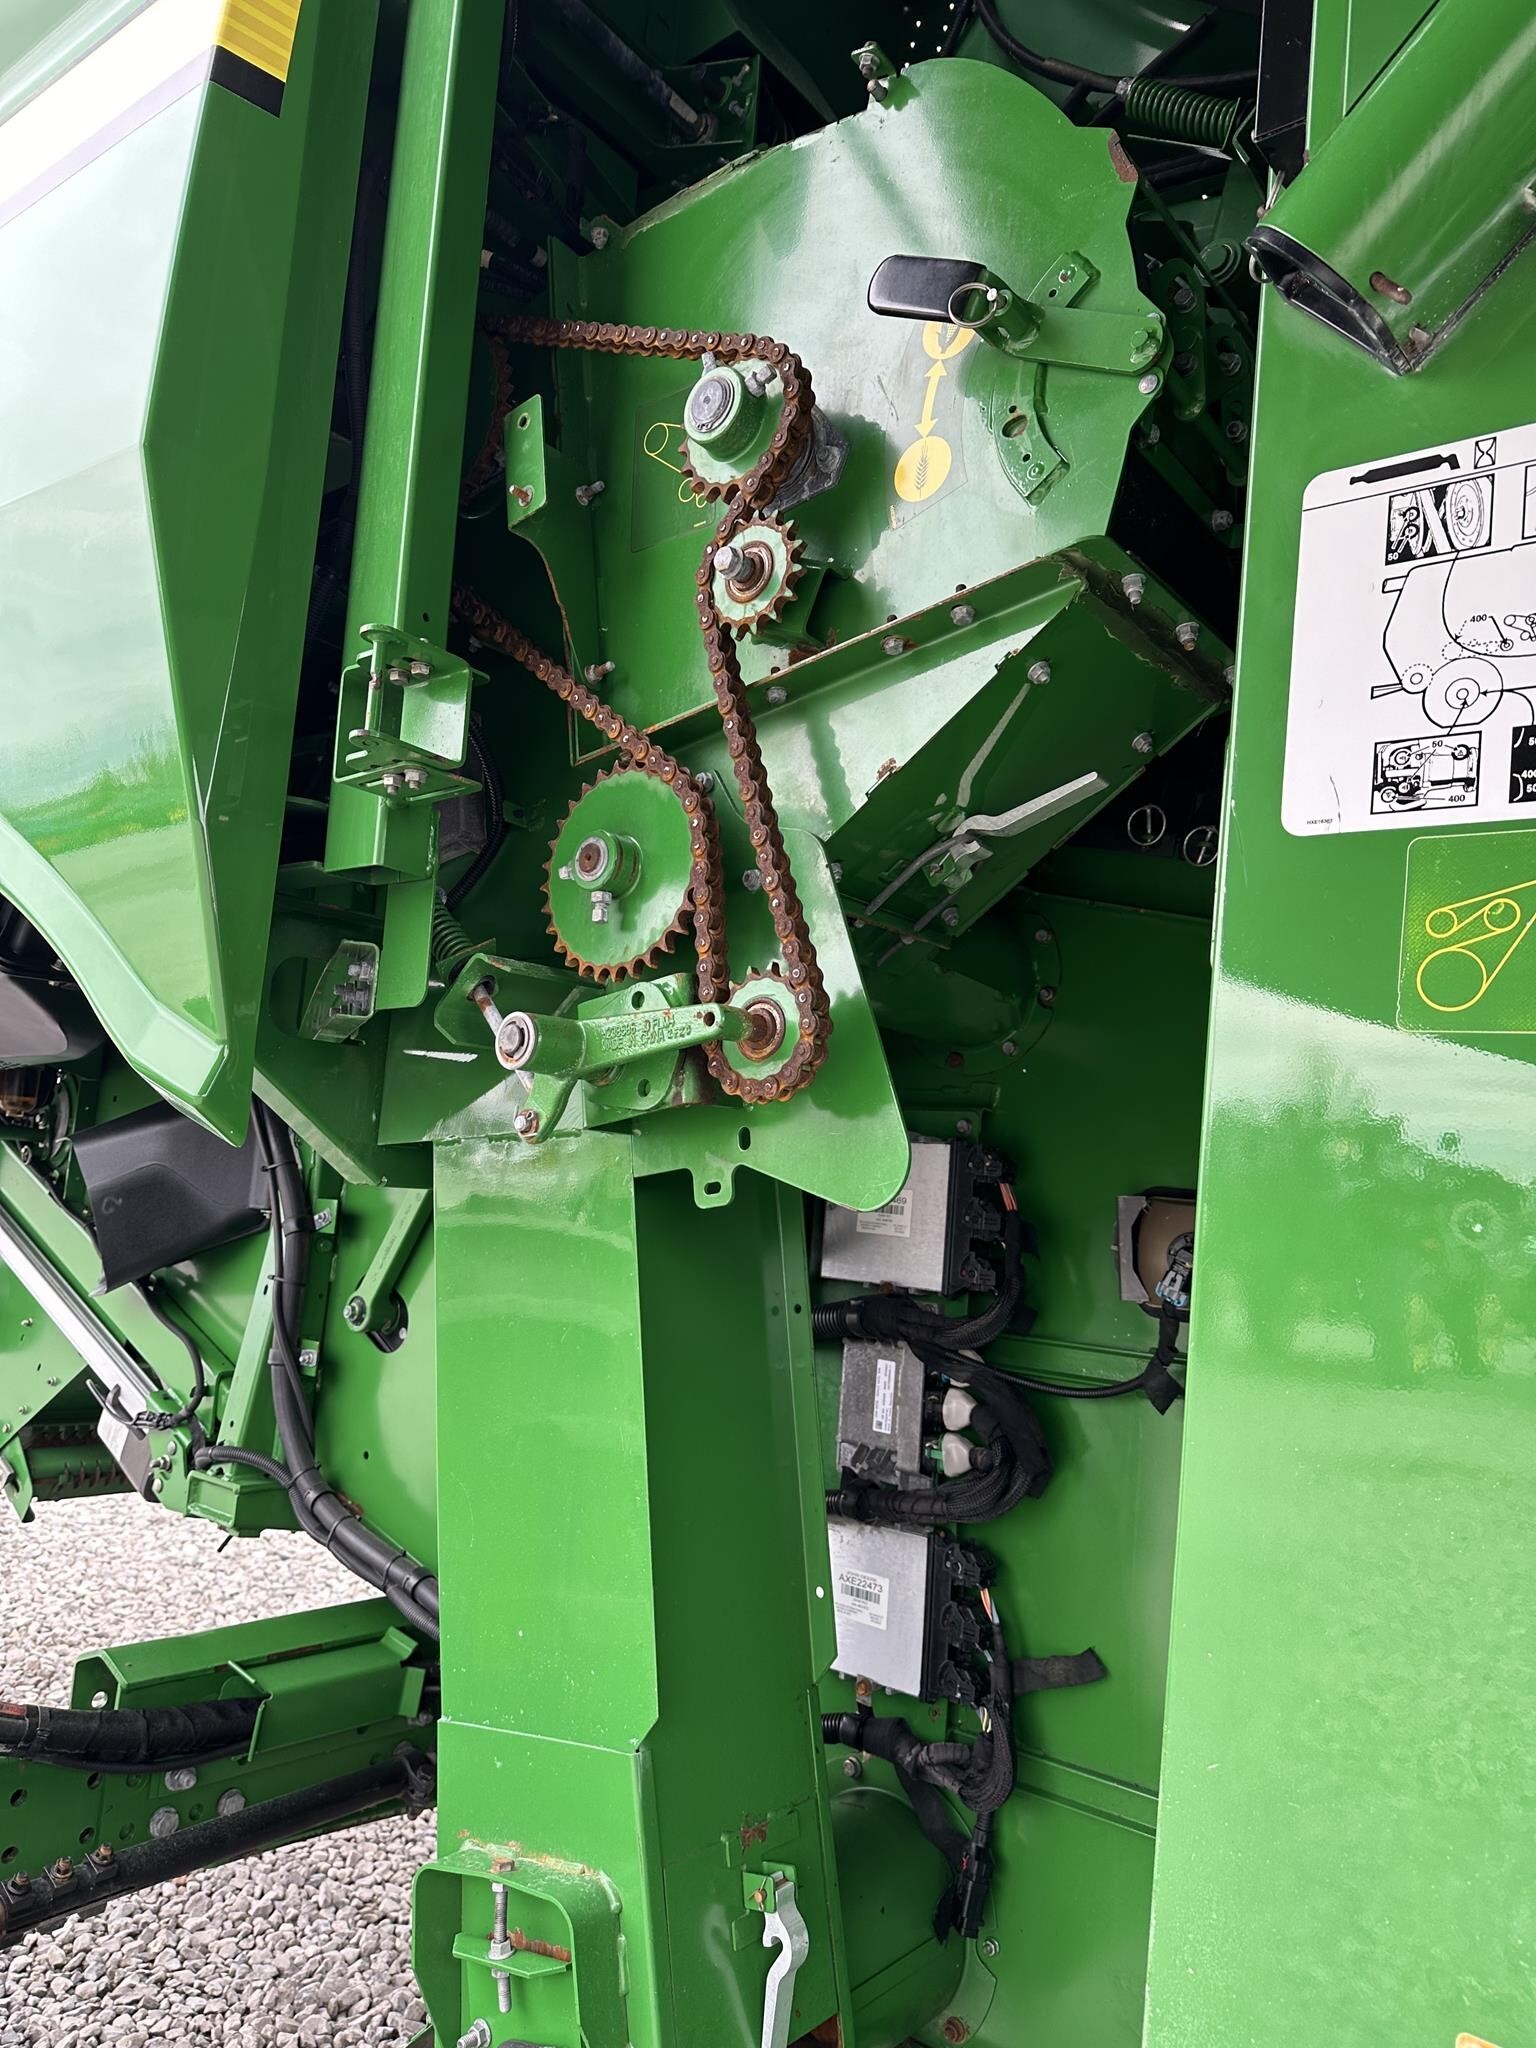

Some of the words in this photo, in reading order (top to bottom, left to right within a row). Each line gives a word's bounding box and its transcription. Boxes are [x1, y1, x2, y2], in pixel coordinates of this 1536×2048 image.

[1387, 552, 1399, 561] 50
[1470, 613, 1487, 623] 400
[1432, 740, 1443, 748] 50
[1448, 794, 1465, 802] 400
[839, 1573, 883, 1593] AXE22473
